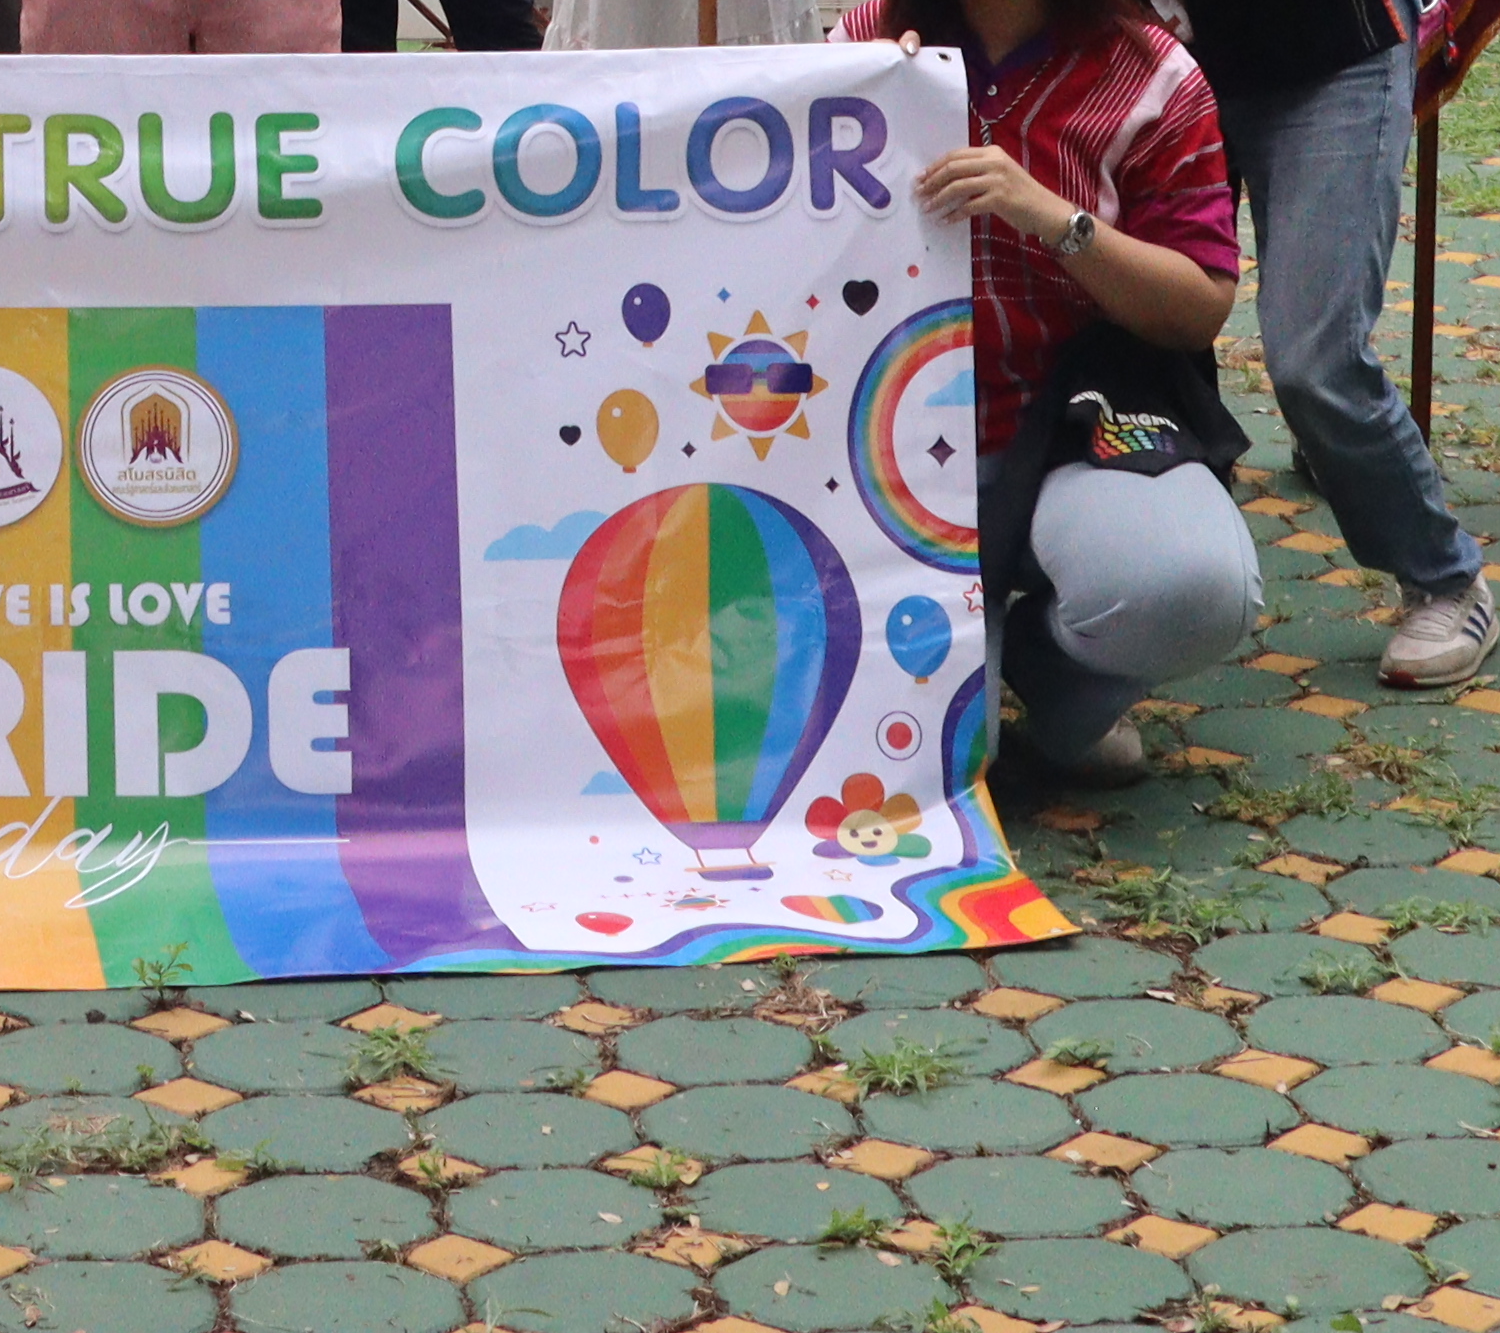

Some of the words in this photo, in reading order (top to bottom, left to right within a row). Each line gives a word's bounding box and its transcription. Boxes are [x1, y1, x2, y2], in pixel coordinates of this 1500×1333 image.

[396, 95, 893, 217] COLOR
[50, 582, 90, 626] IS
[108, 582, 231, 627] LOVE
